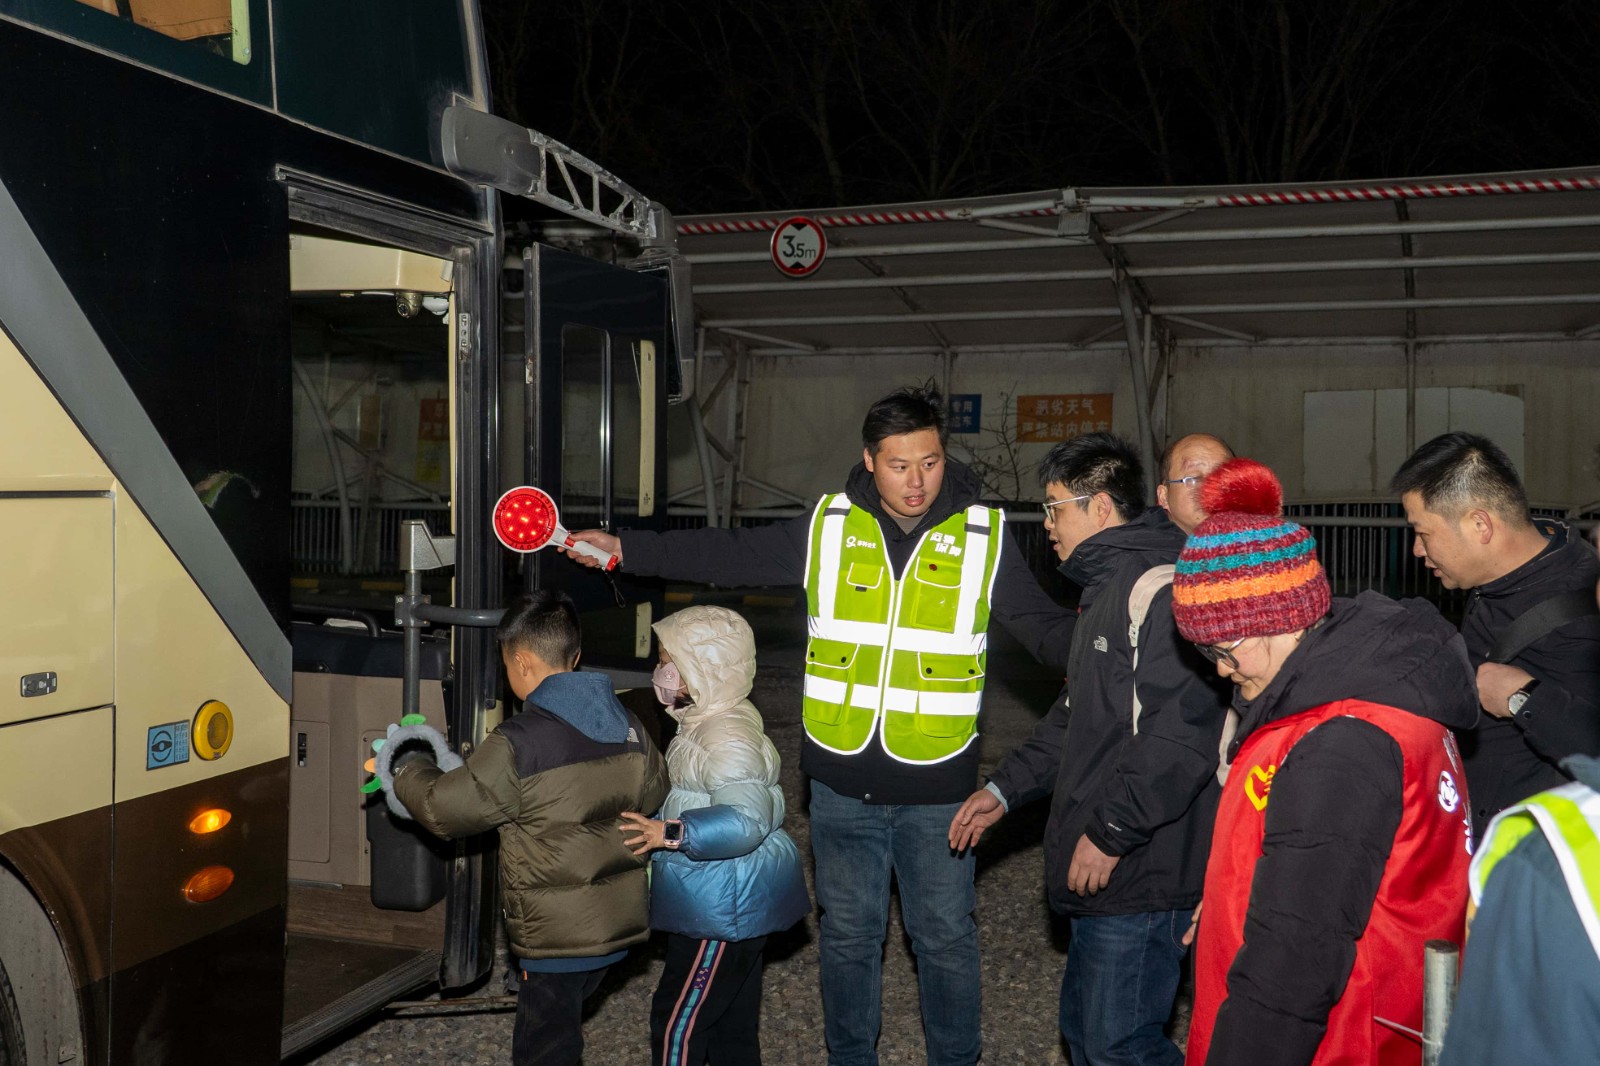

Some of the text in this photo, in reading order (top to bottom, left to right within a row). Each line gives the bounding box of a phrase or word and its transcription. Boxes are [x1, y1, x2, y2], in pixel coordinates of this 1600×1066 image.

[782, 234, 816, 258] 3.5m
[1035, 398, 1095, 416] 恶劣天气
[1021, 420, 1109, 438] 严禁站内停车
[495, 493, 511, 520] STOP
